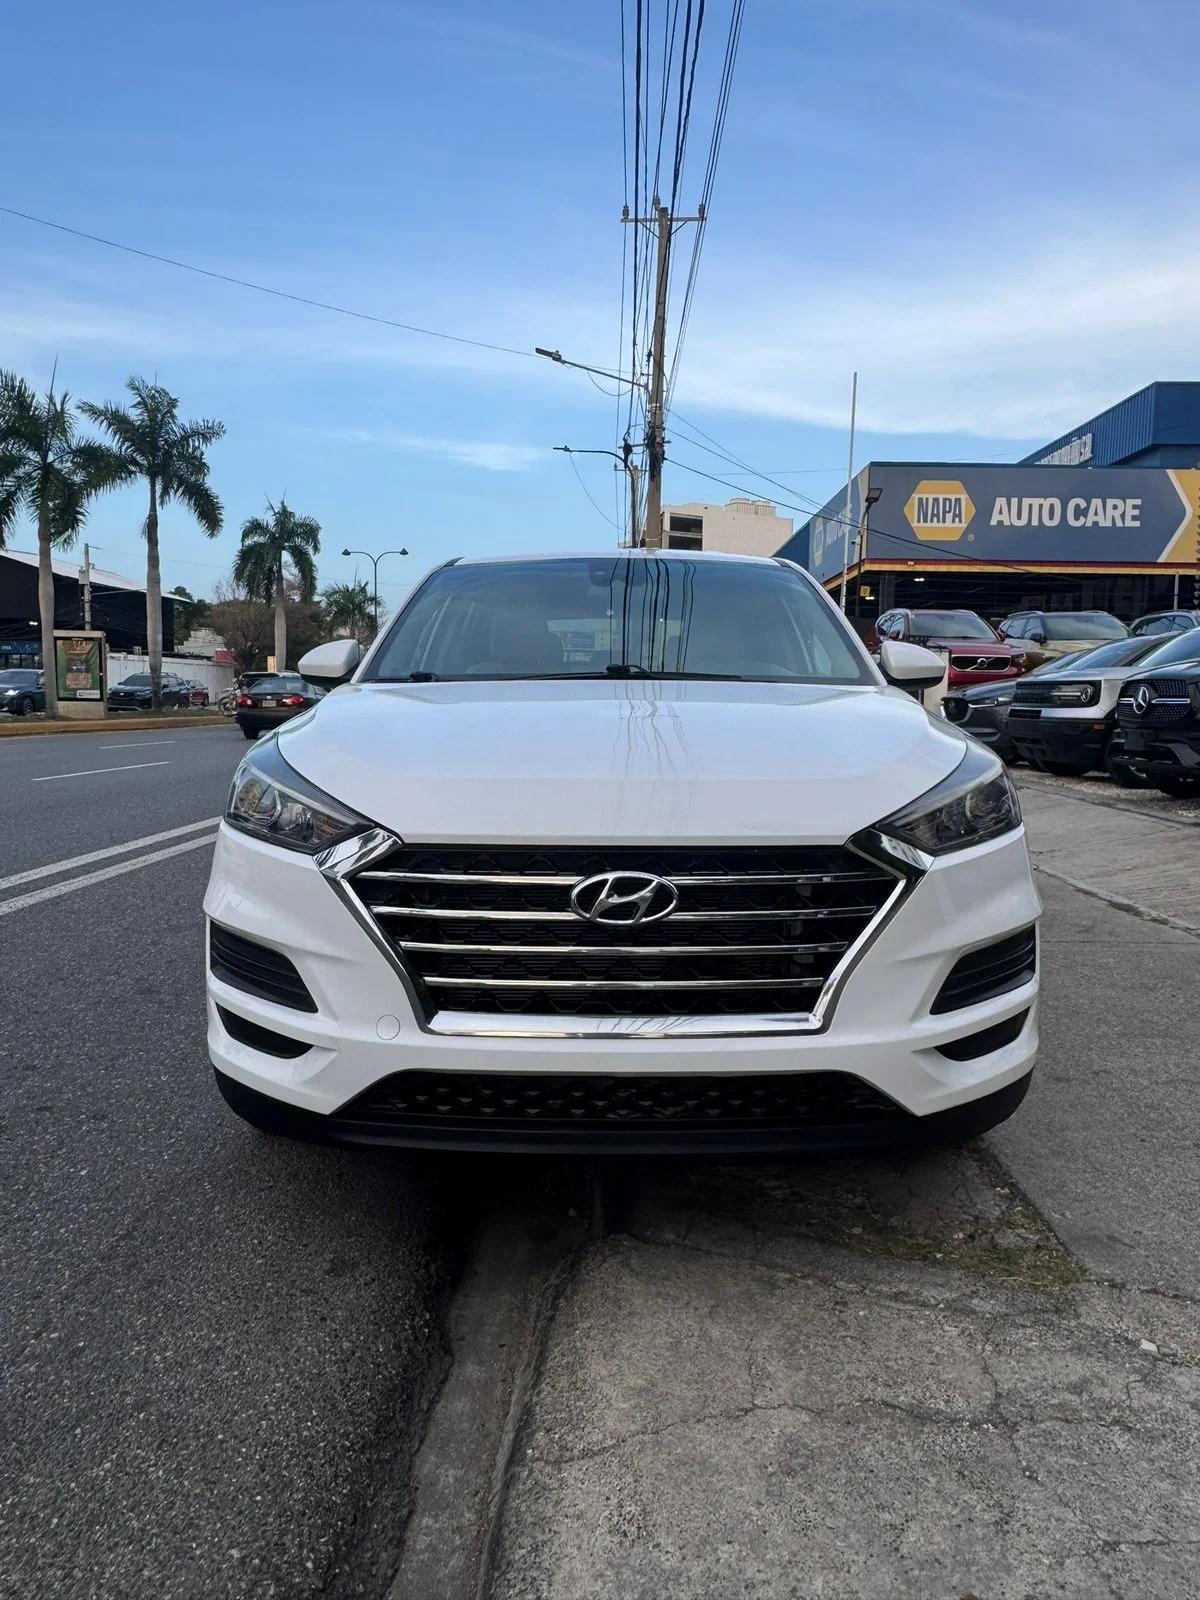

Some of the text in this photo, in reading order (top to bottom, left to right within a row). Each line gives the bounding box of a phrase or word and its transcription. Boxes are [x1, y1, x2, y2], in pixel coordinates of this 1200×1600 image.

[917, 496, 1142, 527] NAPA AUTO CARE
